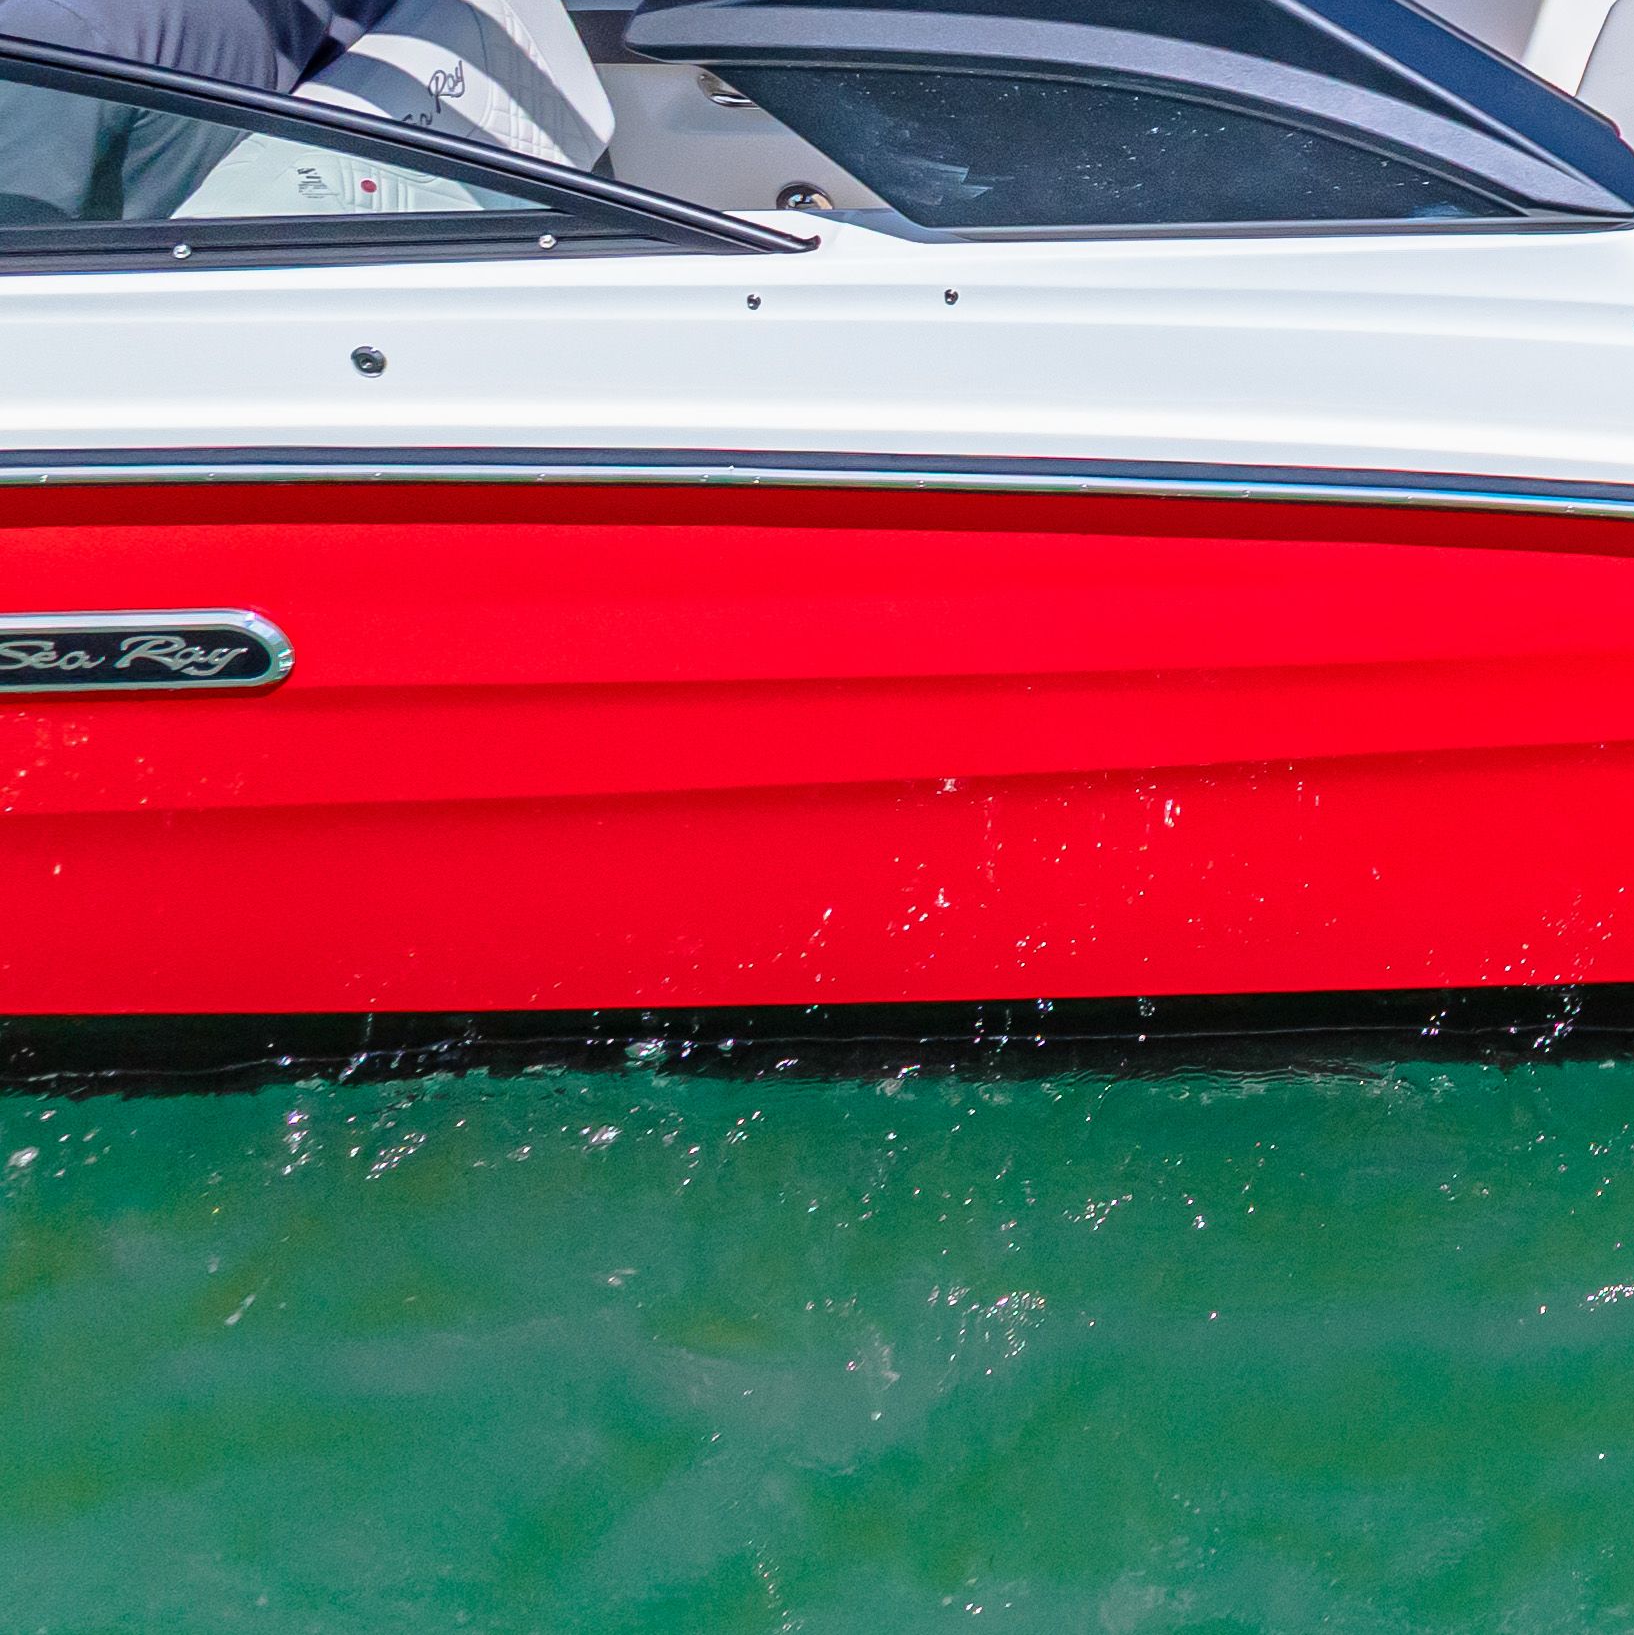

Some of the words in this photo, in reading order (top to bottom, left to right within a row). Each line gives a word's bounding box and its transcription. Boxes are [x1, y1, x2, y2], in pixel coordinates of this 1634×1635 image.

[428, 60, 465, 114] Ray
[0, 639, 106, 670] Sea
[113, 635, 248, 676] Ray
